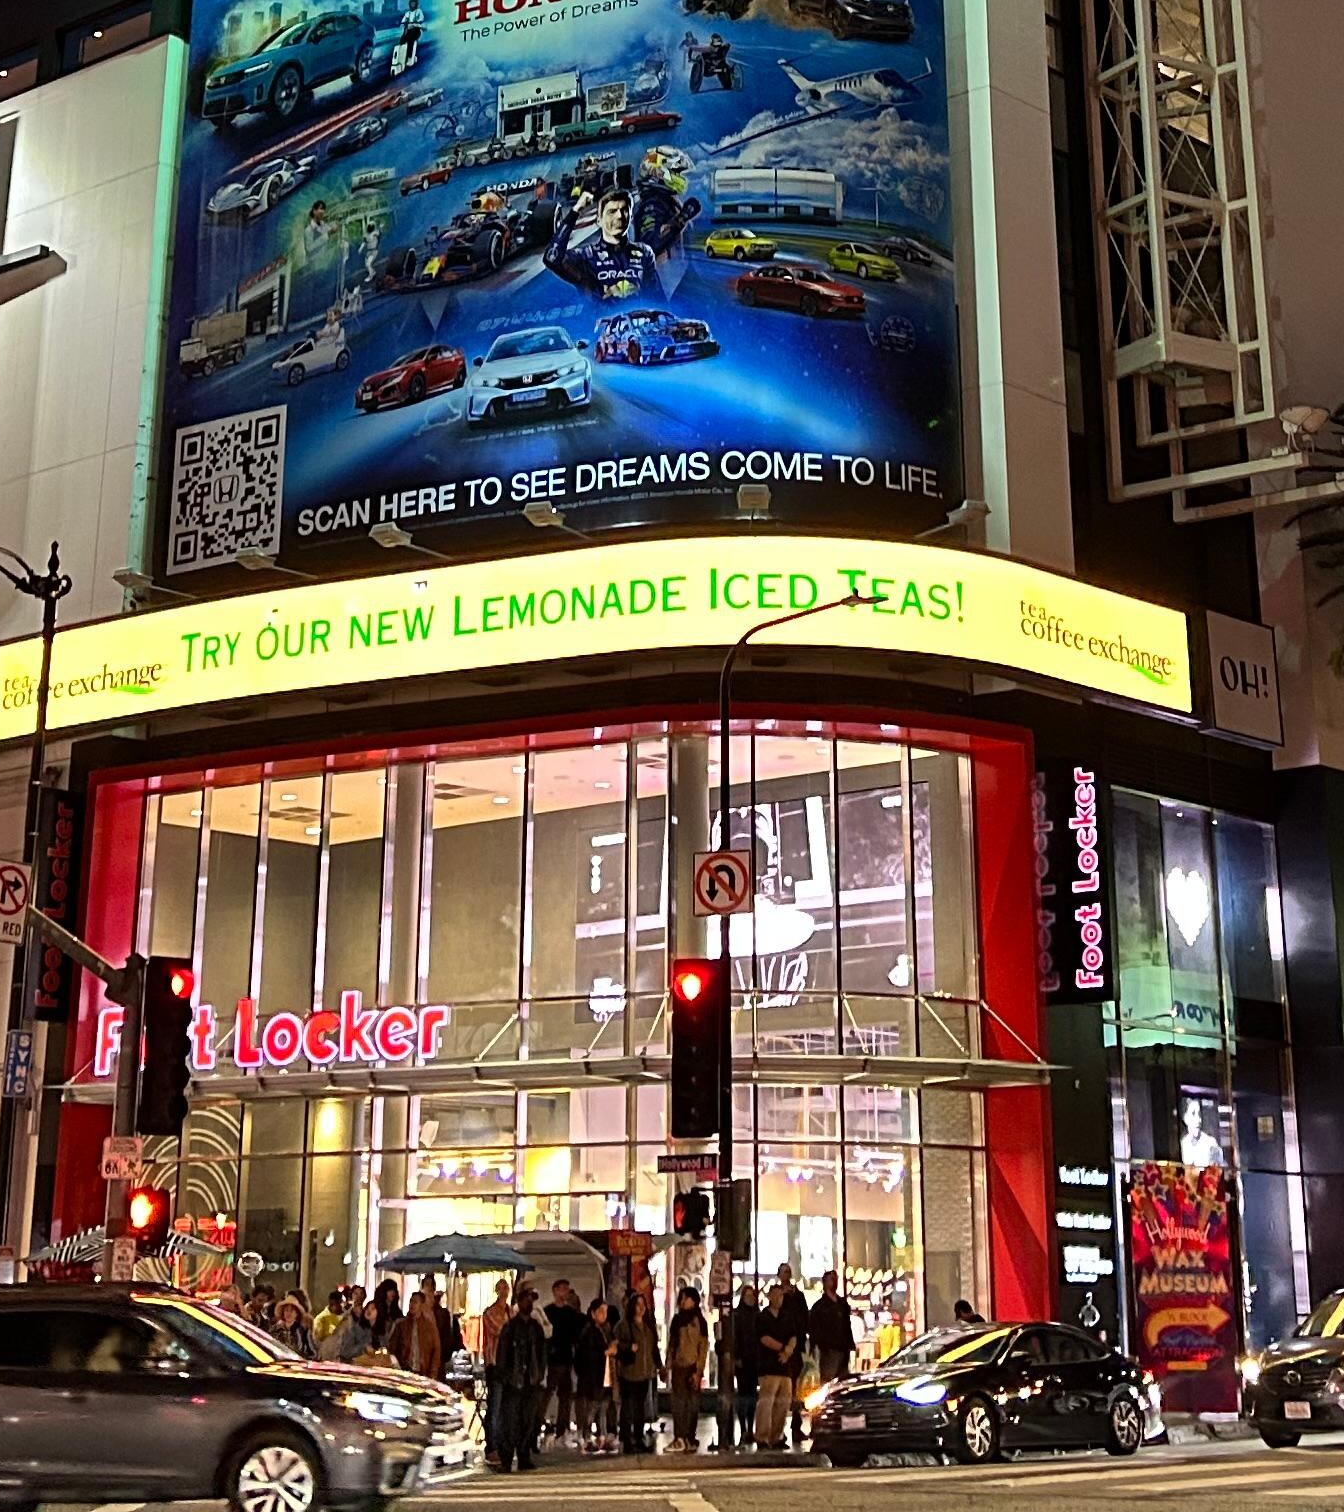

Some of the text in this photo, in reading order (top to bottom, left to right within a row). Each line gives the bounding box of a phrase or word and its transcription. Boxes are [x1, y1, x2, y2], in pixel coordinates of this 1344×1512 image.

[460, 27, 490, 42] The
[493, 13, 546, 36] Power
[549, 7, 568, 23] of
[486, 178, 538, 192] HONDA
[597, 270, 643, 280] ORACLE
[297, 498, 370, 537] SCAN
[380, 483, 456, 522] HERE
[464, 477, 502, 507] TO
[510, 467, 566, 501] SEE
[575, 452, 710, 493] DREAMS
[721, 451, 823, 481] COME
[832, 454, 875, 486] TO
[884, 461, 944, 500] LIFE.
[181, 568, 965, 672] TRY OUR NEW LEMONADE ICED TEAS!
[1020, 600, 1046, 621] tea
[1020, 615, 1172, 679] coffee exchange
[3, 663, 162, 710] cofe exchange
[1220, 656, 1269, 699] OH!
[1068, 767, 1104, 989] Foot Locker
[34, 800, 74, 1008] Foo Locker
[3, 921, 22, 937] RED
[93, 1003, 216, 1077] Ft
[233, 989, 451, 1069] Locker
[13, 1034, 31, 1093] SYNC
[660, 1157, 701, 1171] Hollywood
[1146, 1216, 1211, 1251] Hollywood
[1151, 1245, 1206, 1270] WAX
[1138, 1270, 1229, 1295] MUSEUM
